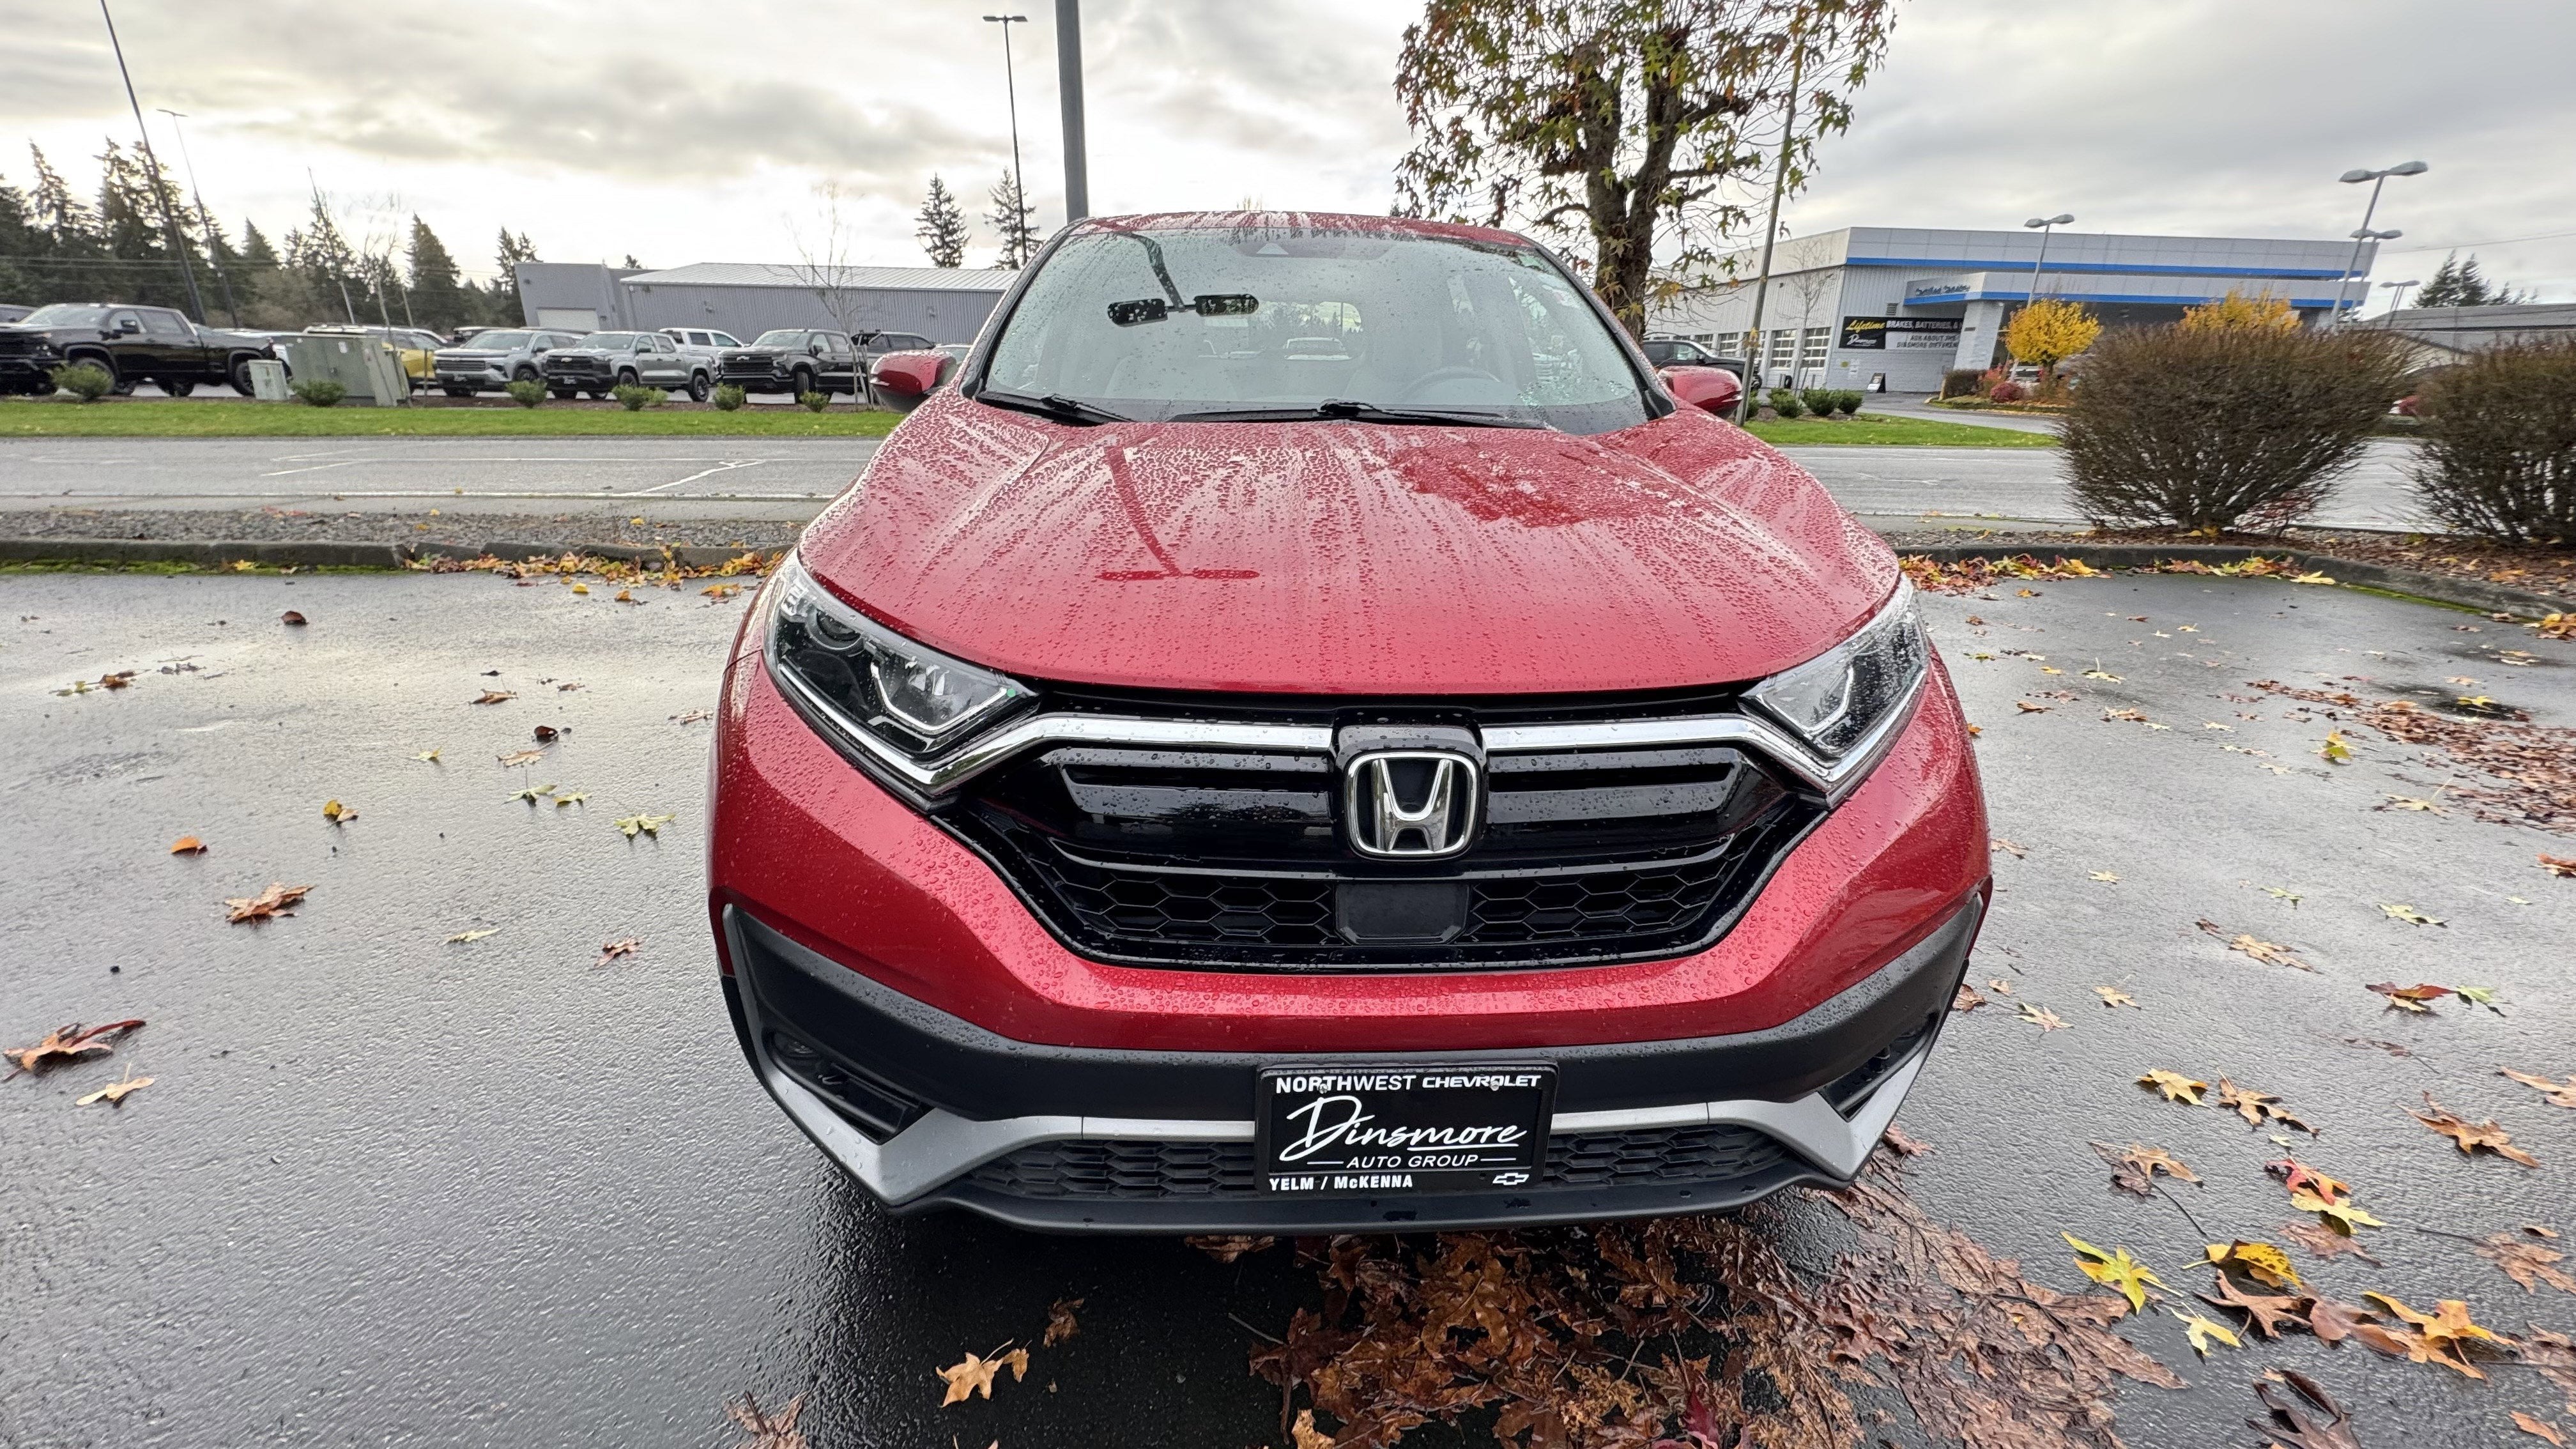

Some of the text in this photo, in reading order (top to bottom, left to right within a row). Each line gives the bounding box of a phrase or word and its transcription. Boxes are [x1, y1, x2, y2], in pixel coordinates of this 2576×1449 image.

[1276, 1075, 1542, 1094] NORTHWEST CHEVROLET
[1279, 1094, 1528, 1162] Dinsmore
[1346, 1154, 1478, 1169] AUTO GROUP
[1269, 1176, 1315, 1191] YELM
[1333, 1174, 1413, 1190] McKENNA
